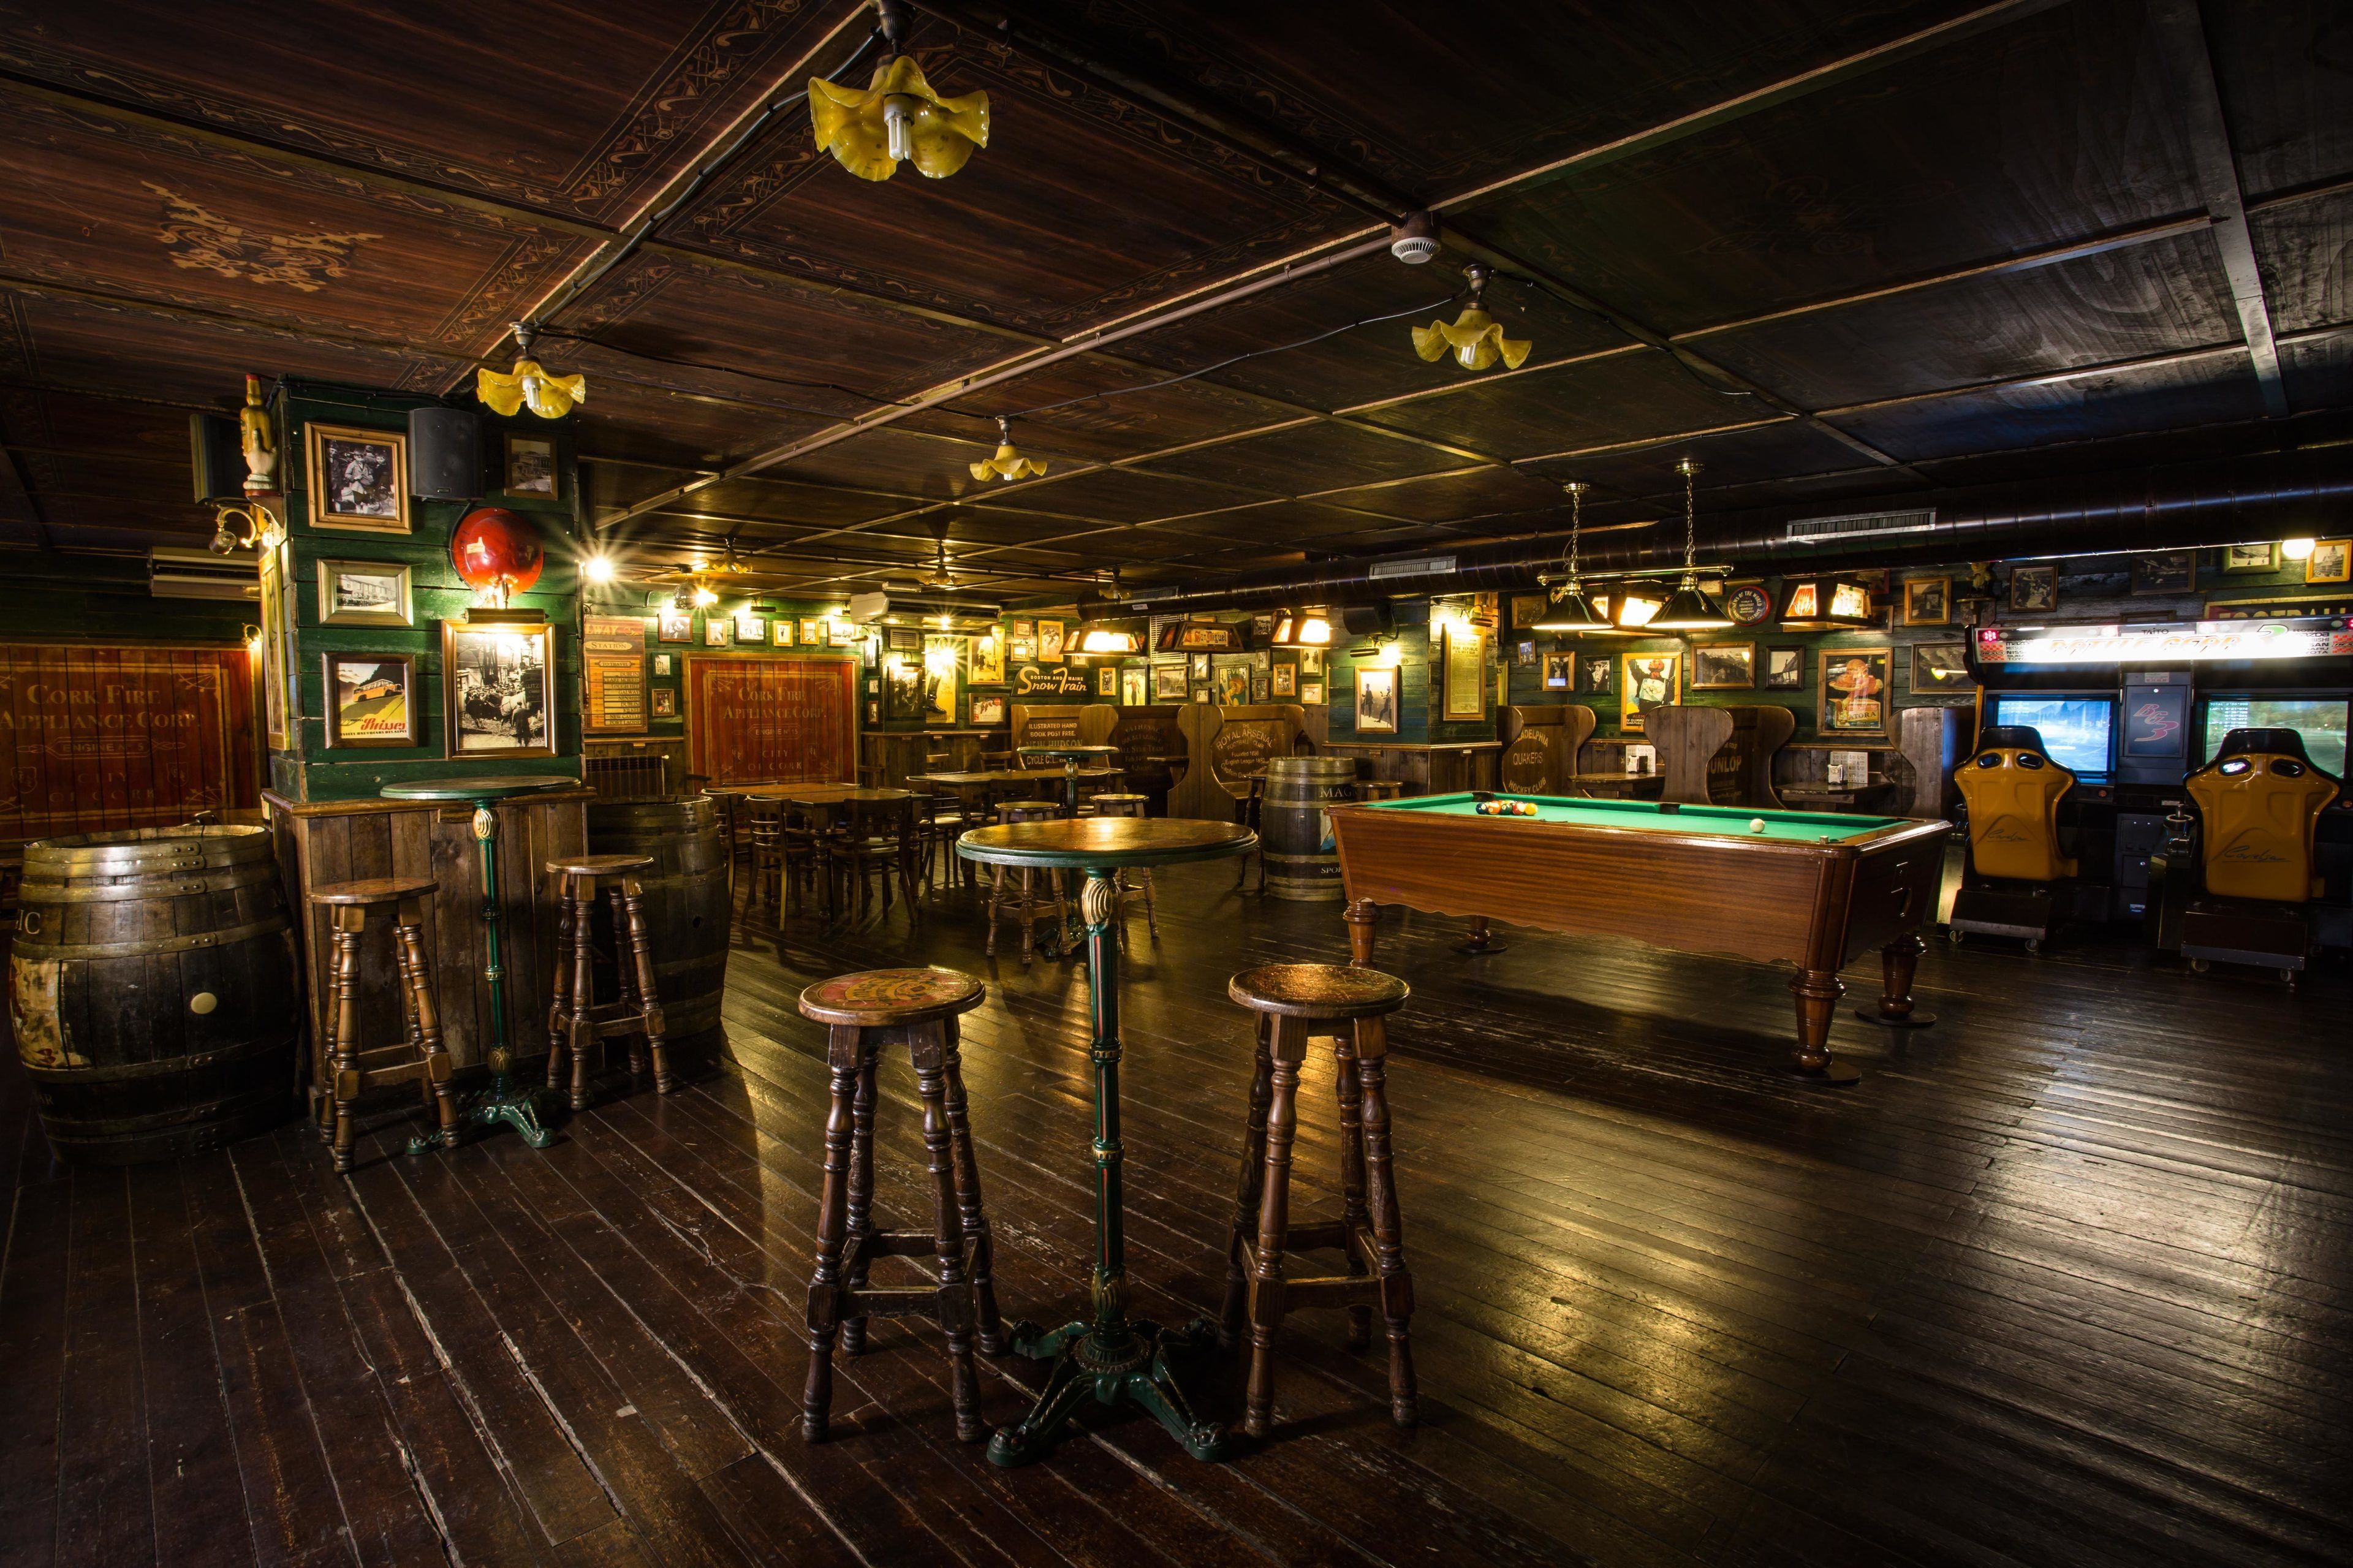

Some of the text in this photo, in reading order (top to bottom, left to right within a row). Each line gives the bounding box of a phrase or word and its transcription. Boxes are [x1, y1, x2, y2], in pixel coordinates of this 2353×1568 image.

[1207, 631, 1227, 643] Miguel
[1018, 665, 1088, 695] Snow Train
[27, 684, 161, 705] CORK FIRE
[738, 686, 806, 702] CORK FIRE
[724, 705, 792, 719] APPLIANCE
[1850, 711, 1877, 721] ATORA
[0, 710, 133, 730] APPLIANCE
[1048, 738, 1083, 747] HUDSON
[1216, 729, 1273, 751] ROYAL ARSENAL
[1516, 729, 1549, 748] LADELPHIA
[63, 743, 115, 753] ENGINE
[762, 749, 789, 758] CITY
[1026, 755, 1045, 765] CYCLE
[1513, 751, 1544, 765] QUAKERS
[770, 762, 803, 771] CORK
[78, 771, 129, 786] CITY
[1509, 776, 1547, 795] HOCKEY CLUB
[92, 789, 155, 801] CORK
